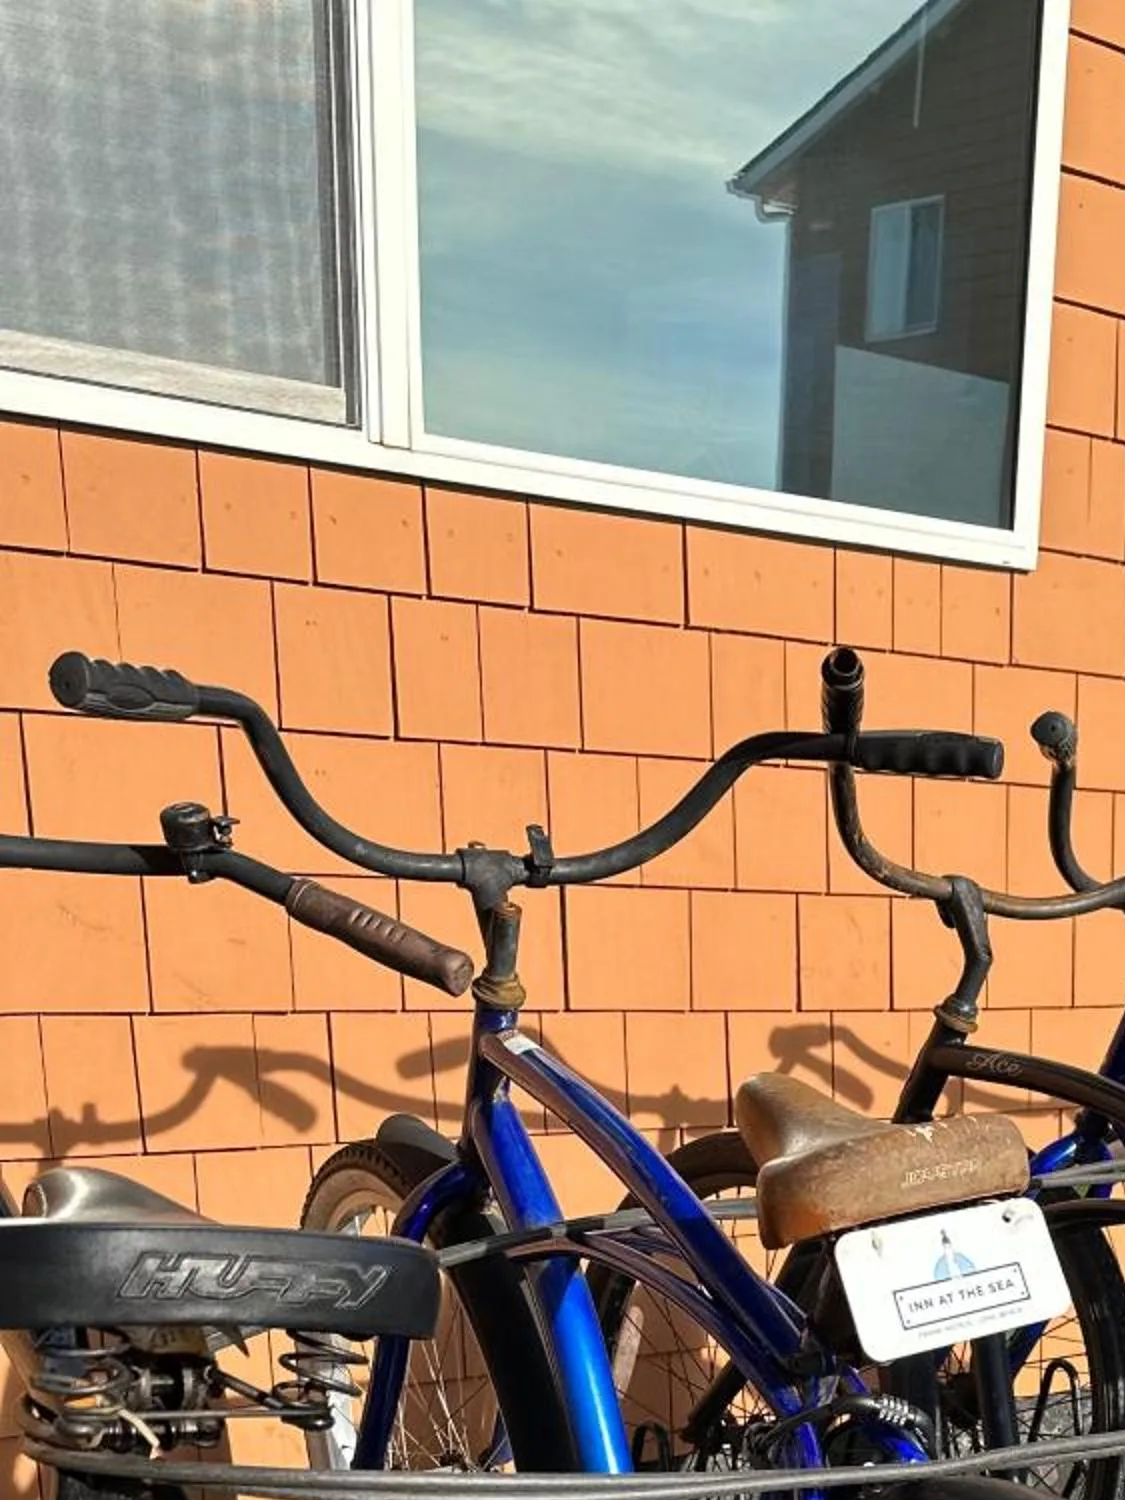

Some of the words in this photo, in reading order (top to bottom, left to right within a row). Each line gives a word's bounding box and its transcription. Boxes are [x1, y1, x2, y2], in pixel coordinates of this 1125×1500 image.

[117, 1250, 392, 1310] HUFFY
[908, 1299, 934, 1313] INN
[939, 1293, 954, 1305] AT
[959, 1285, 984, 1300] THE
[987, 1278, 1014, 1293] SEA
